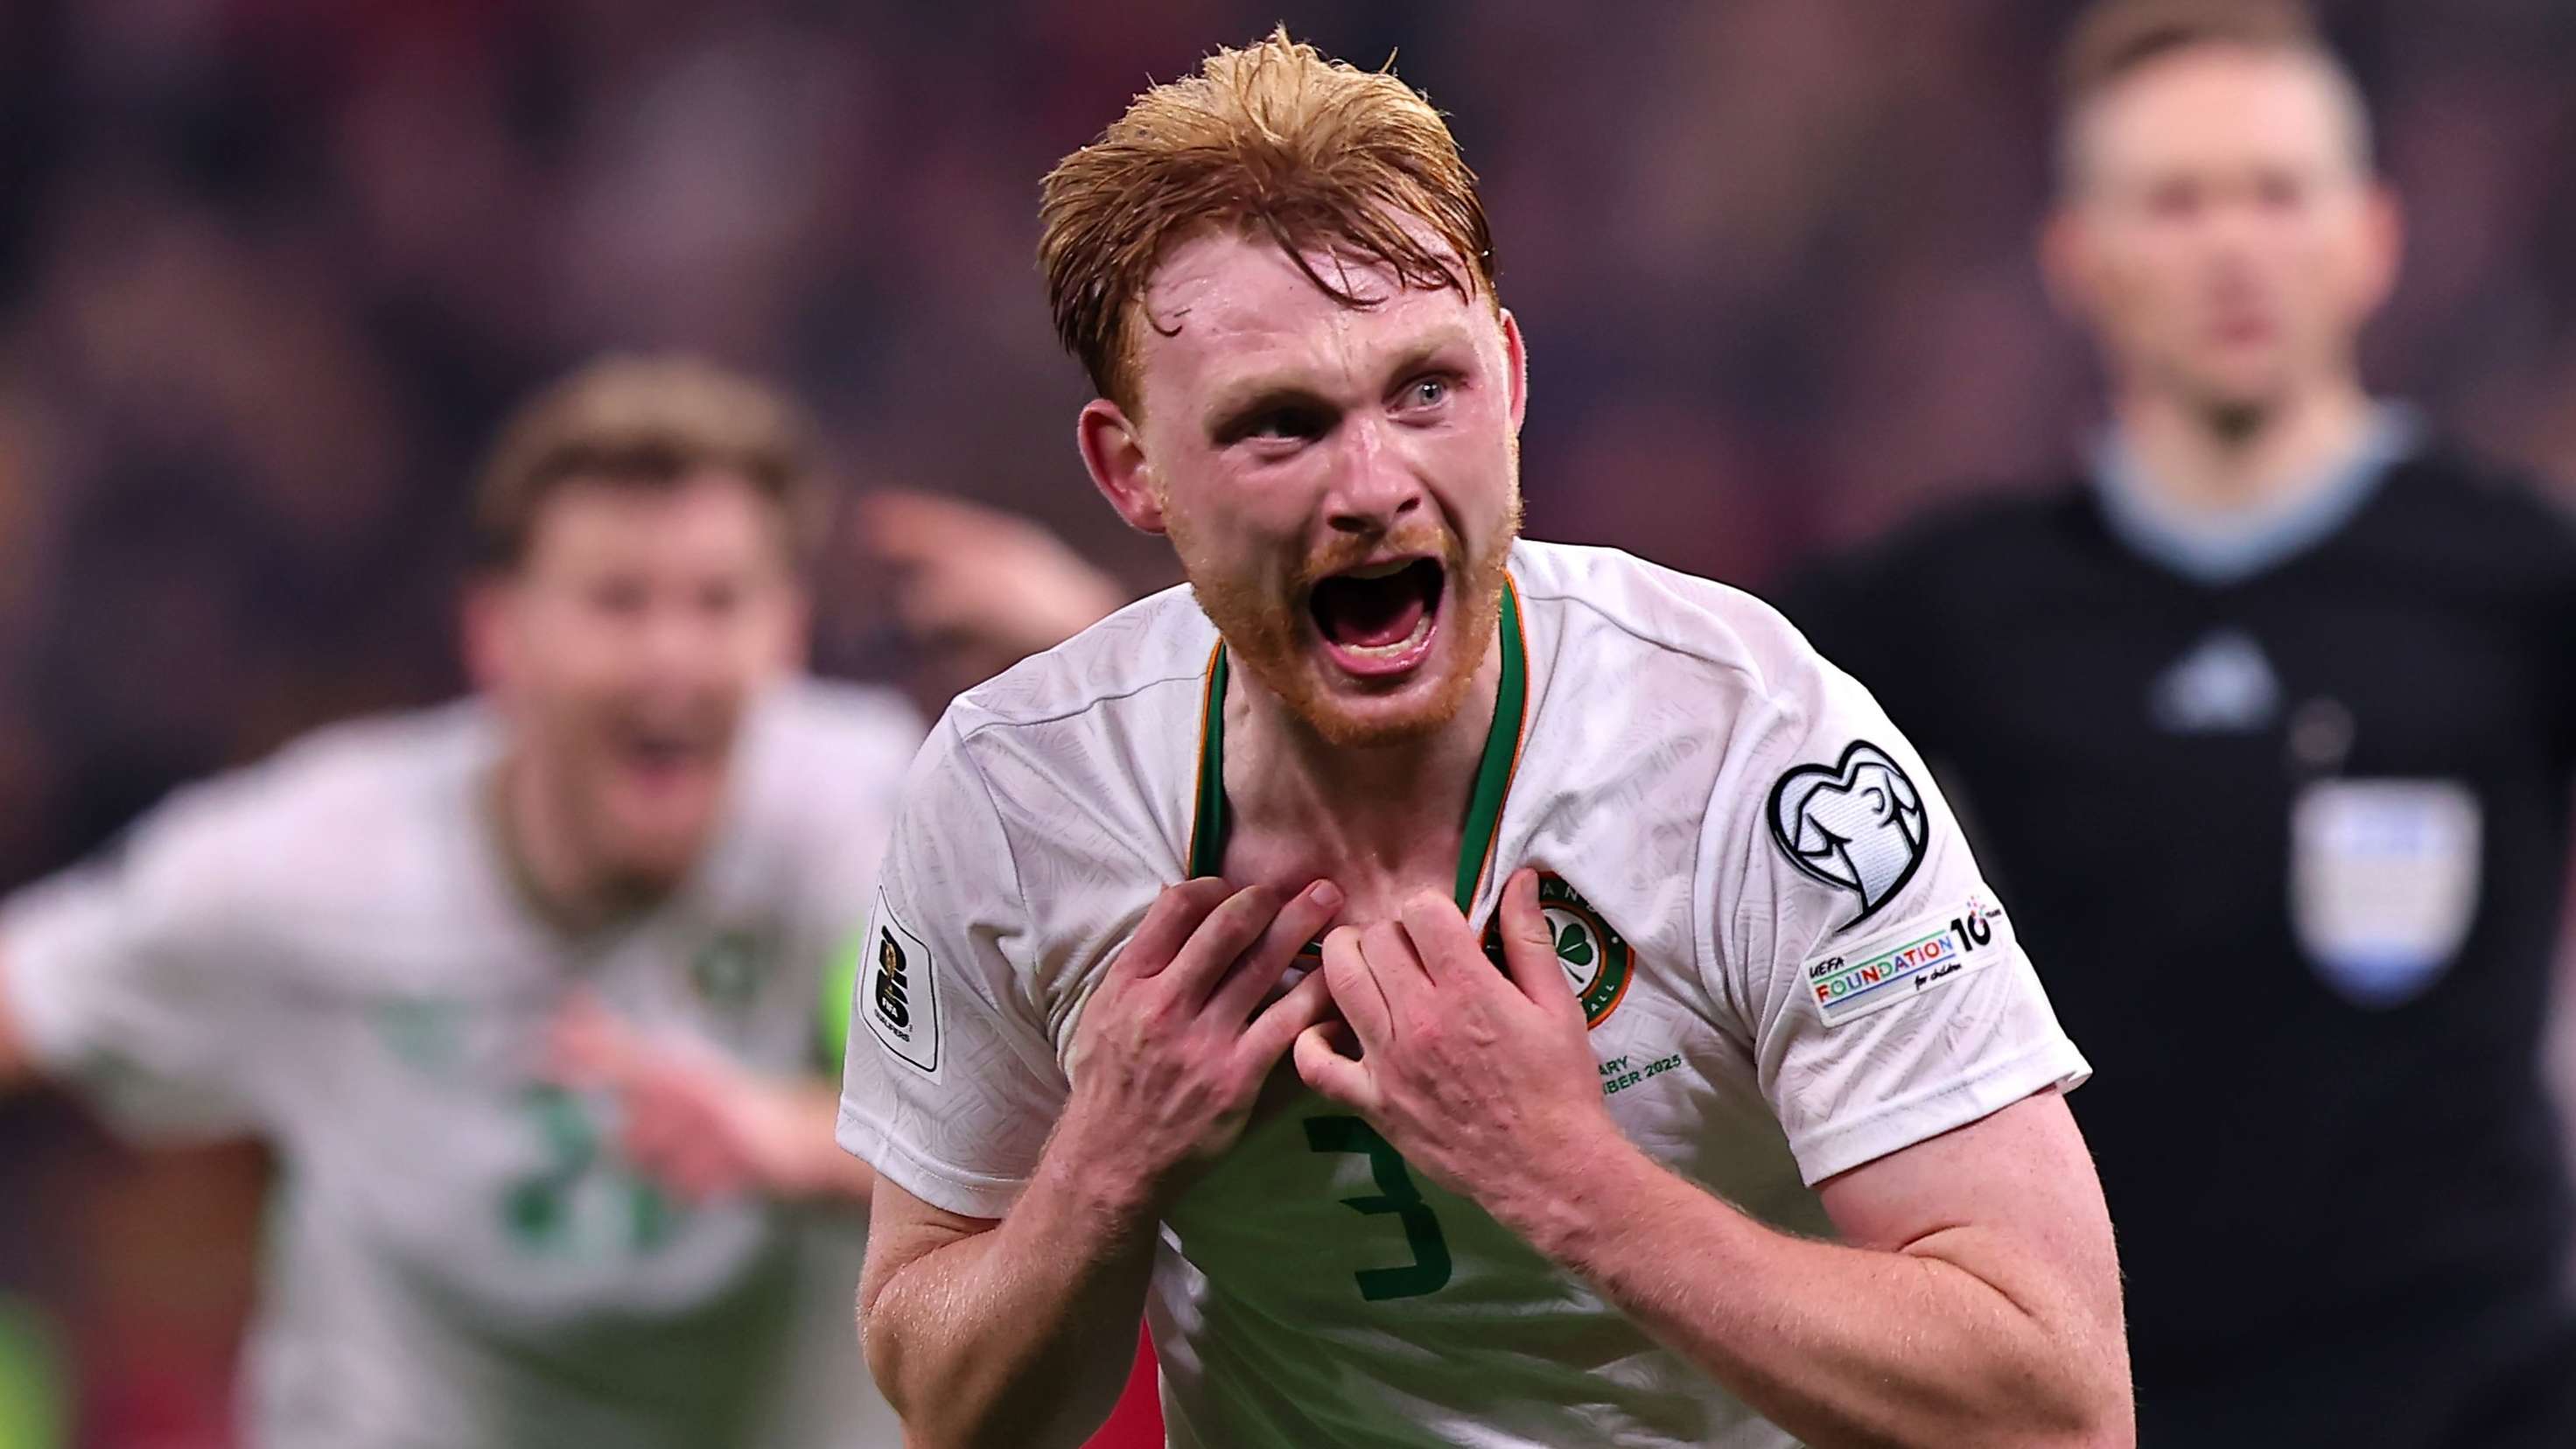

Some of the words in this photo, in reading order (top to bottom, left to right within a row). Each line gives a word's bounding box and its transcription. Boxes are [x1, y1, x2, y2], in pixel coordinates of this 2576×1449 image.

[1809, 956, 1844, 978] UEFA
[1816, 934, 1954, 1003] FOUNDATION
[1914, 975, 1928, 991] for
[1930, 963, 1962, 981] children
[1603, 1071, 1642, 1096] BER
[1644, 1054, 1682, 1077] 2025
[1303, 1116, 1452, 1301] 3
